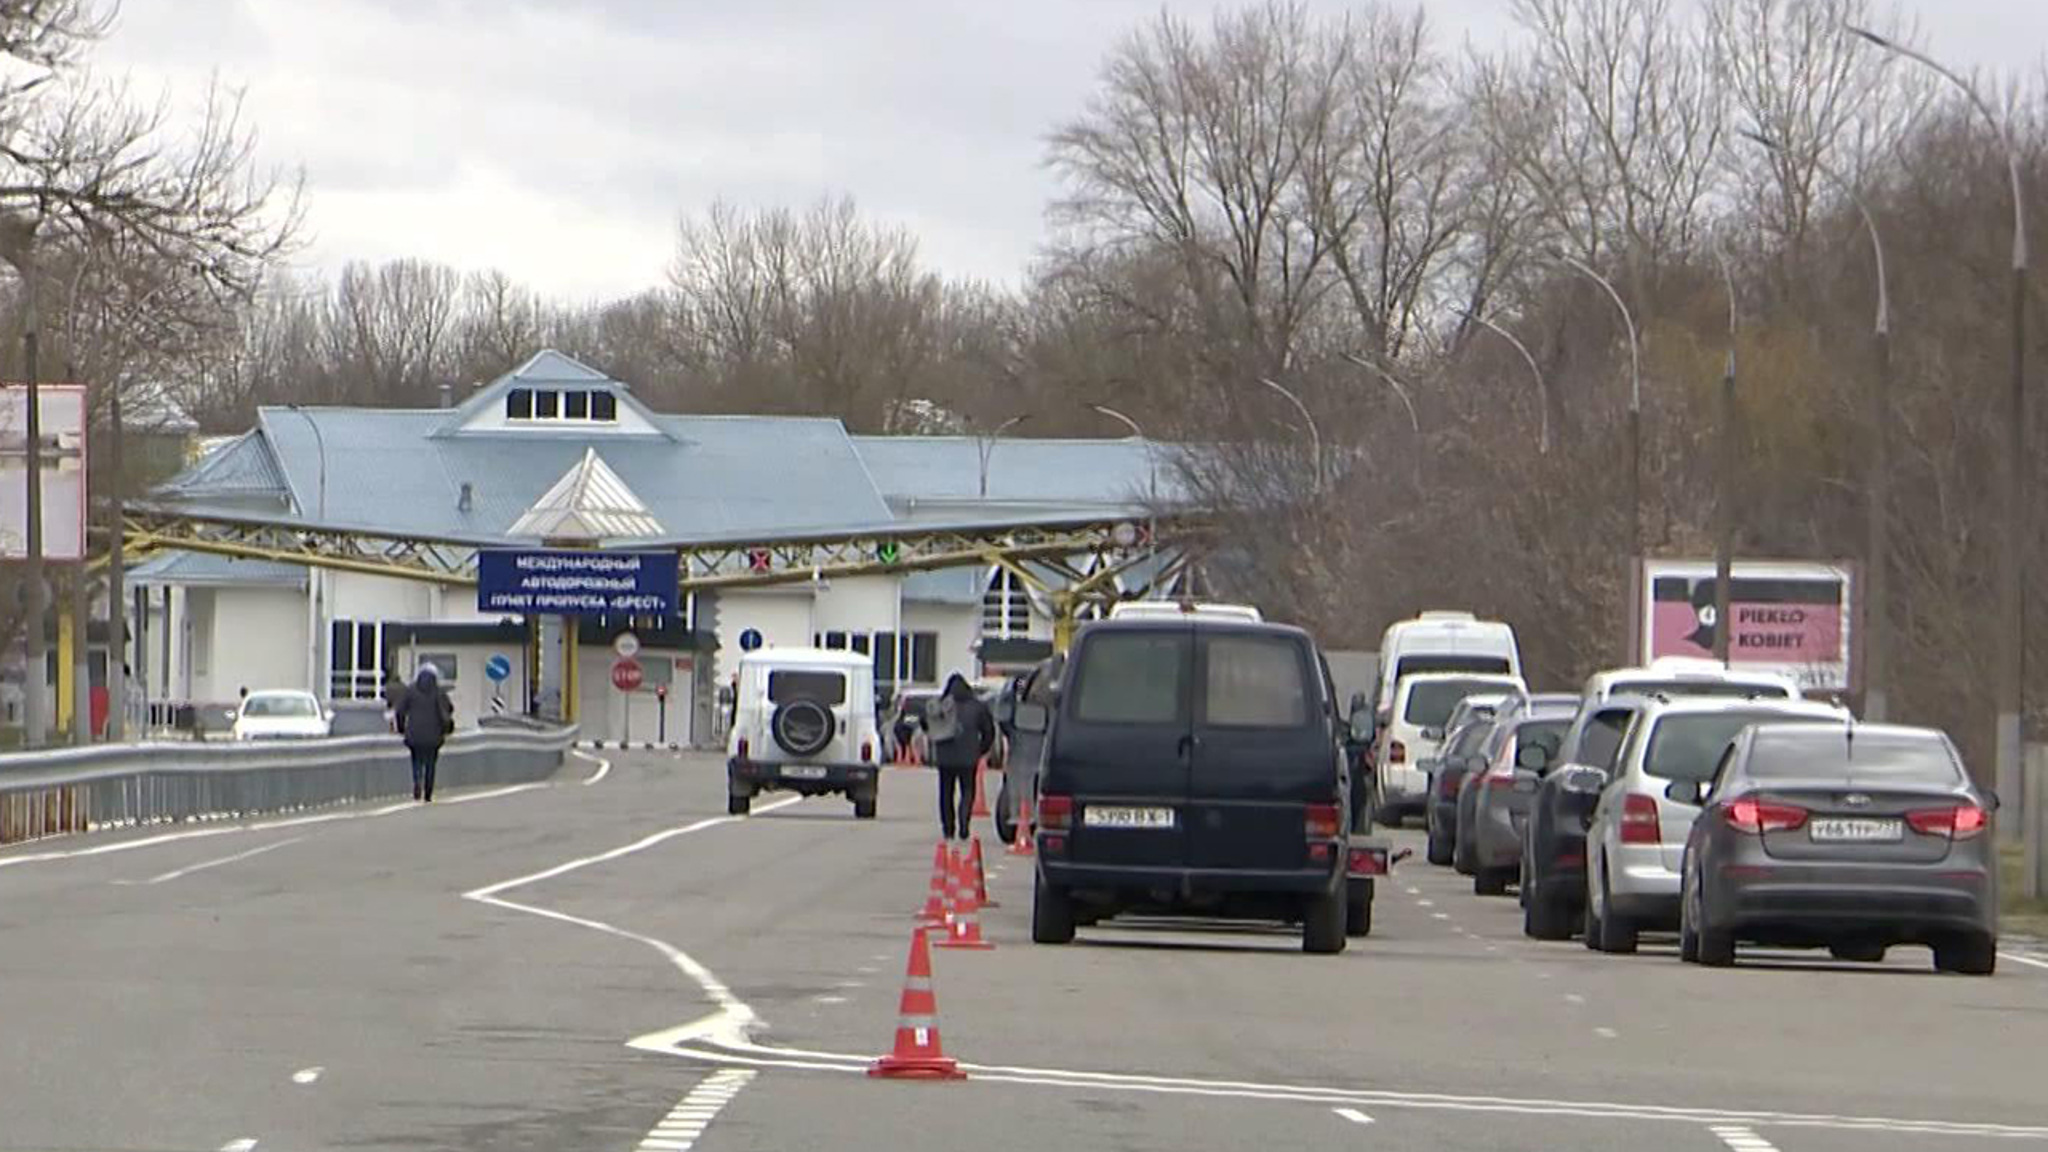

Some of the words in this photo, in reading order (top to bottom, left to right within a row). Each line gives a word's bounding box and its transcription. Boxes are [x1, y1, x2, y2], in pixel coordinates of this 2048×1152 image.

[516, 555, 641, 571] МЕЖДУНАРОДНЫЙ
[521, 575, 636, 589] АВТОДОРОЖНЫЙ
[491, 594, 533, 605] ПУНКТ
[536, 595, 606, 608] ПРОПУСКА
[1739, 608, 1805, 624] PIEKŁO
[1739, 633, 1804, 648] KOBIET
[613, 669, 642, 682] STOP
